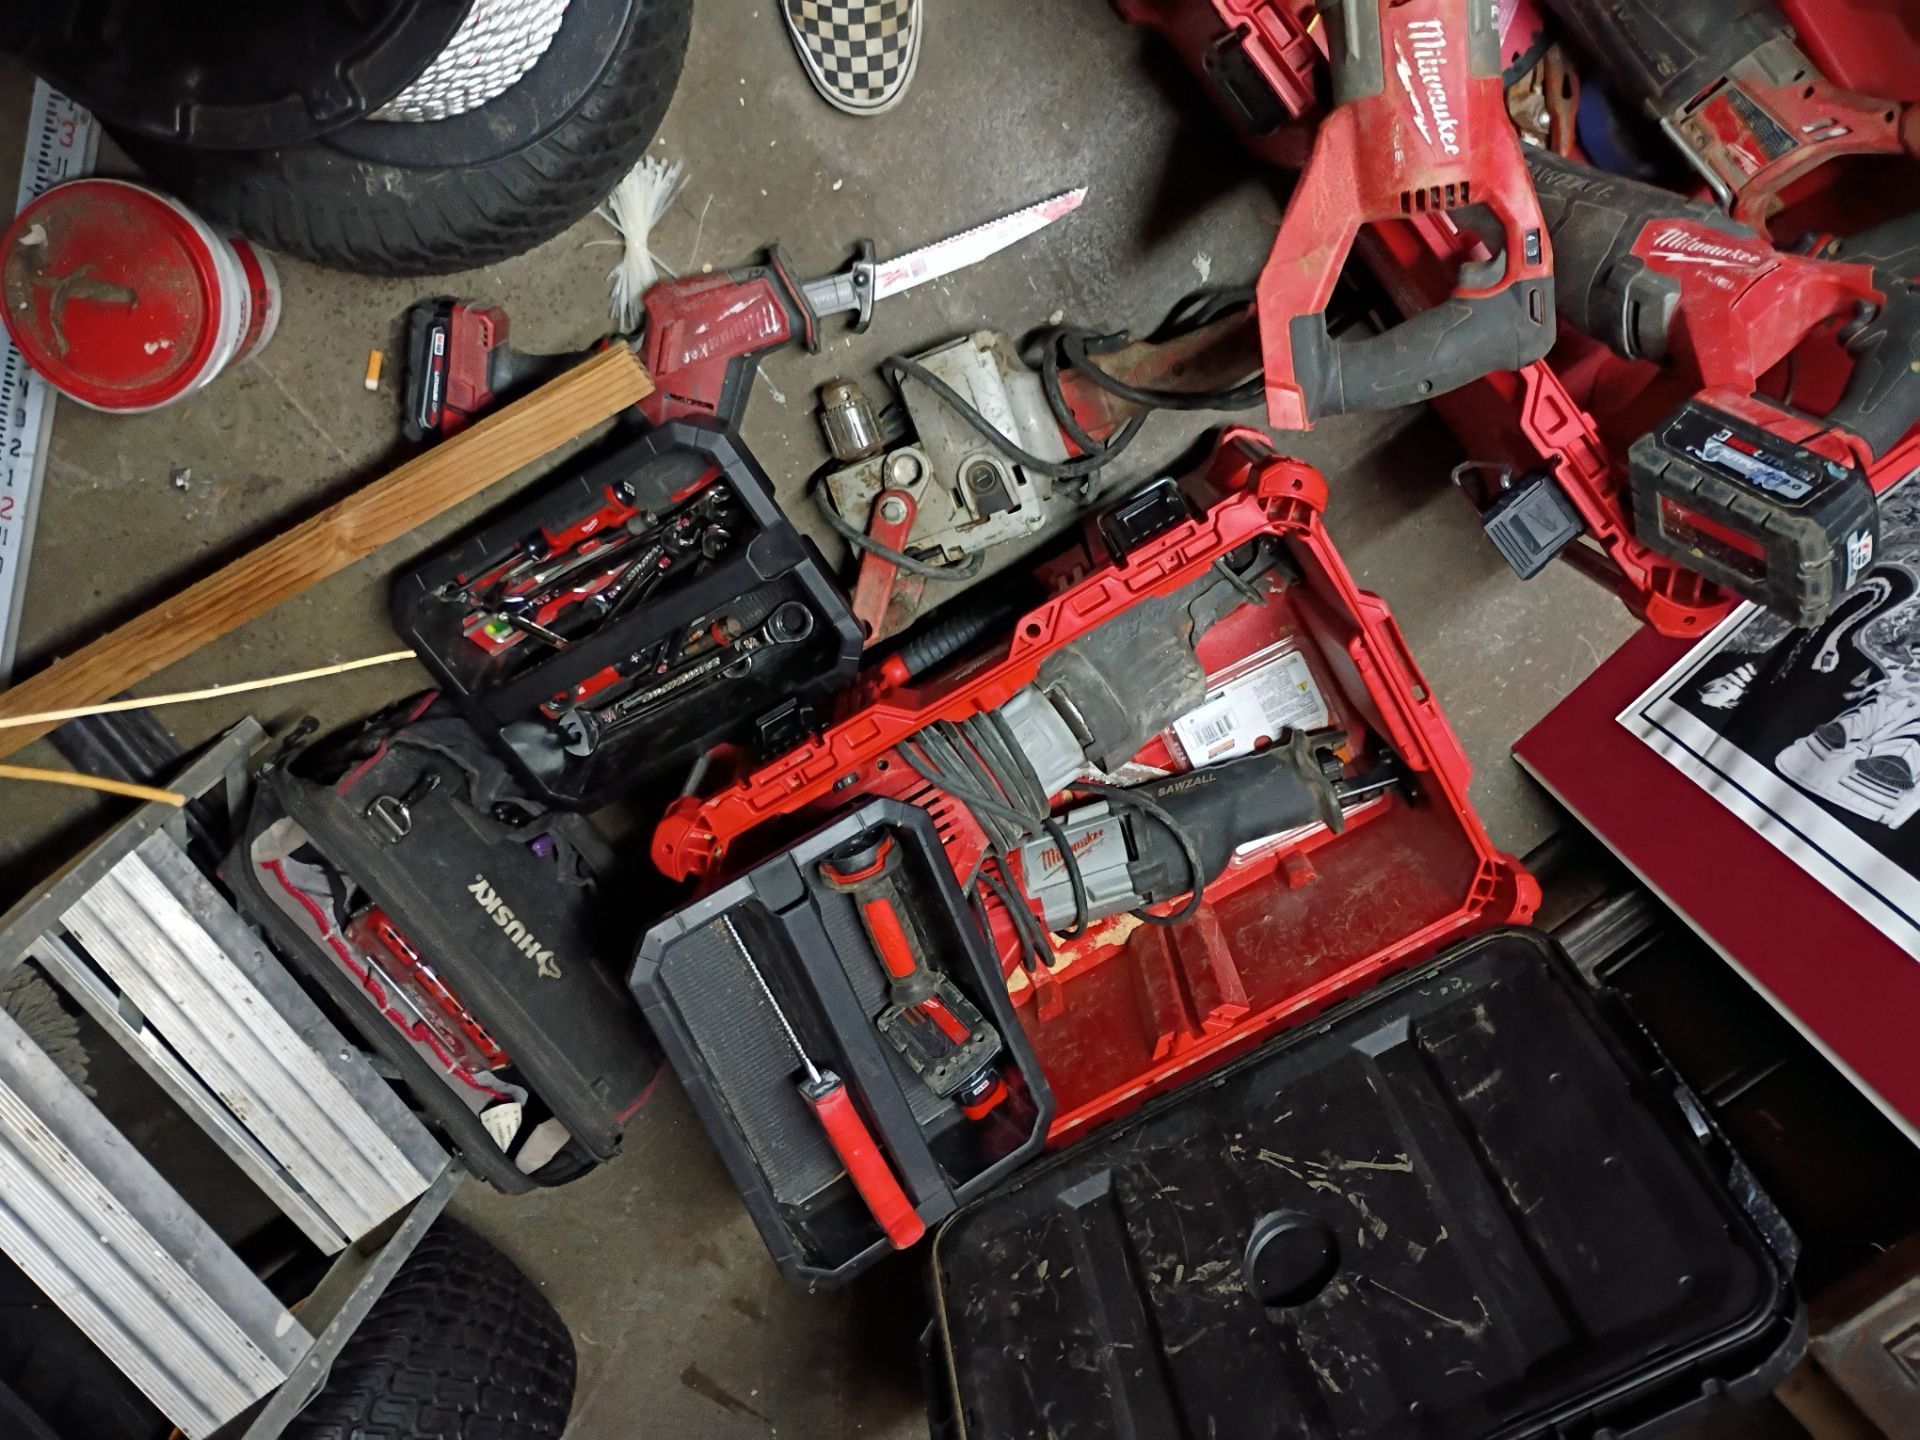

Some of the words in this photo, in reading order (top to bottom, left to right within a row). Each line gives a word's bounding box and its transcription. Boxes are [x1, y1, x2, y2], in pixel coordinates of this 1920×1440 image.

[1407, 19, 1460, 155] Milwaukee
[1653, 227, 1762, 265] Milwaukee
[9, 438, 22, 458] 2
[6, 468, 14, 487] 1
[0, 496, 15, 521] 2
[1157, 773, 1217, 797] SAWZALL
[467, 879, 543, 959] HUSKY
